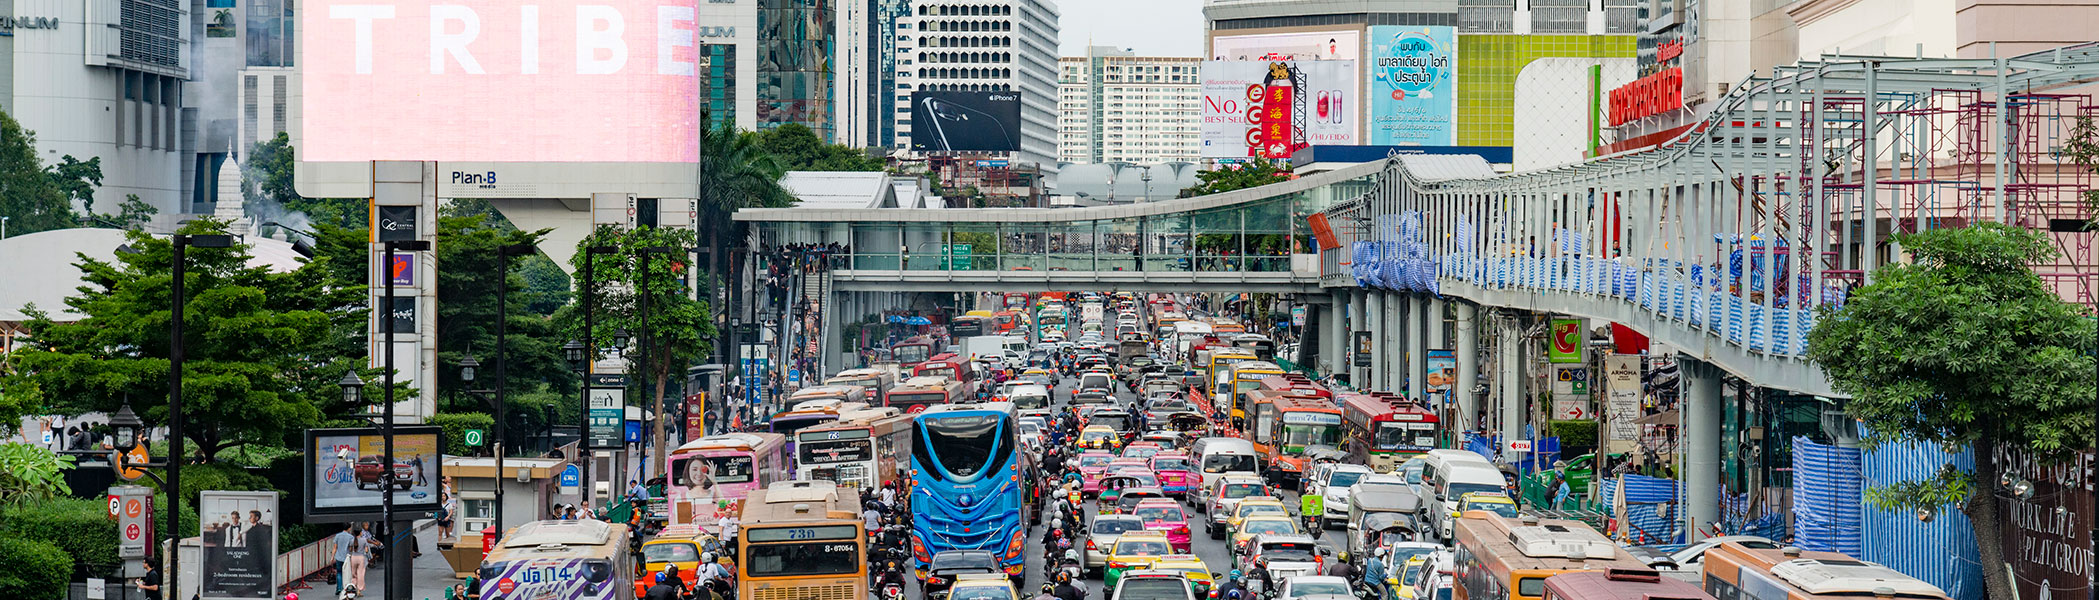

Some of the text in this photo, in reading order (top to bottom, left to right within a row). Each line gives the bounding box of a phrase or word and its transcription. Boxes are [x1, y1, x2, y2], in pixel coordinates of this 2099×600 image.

[329, 4, 695, 76] TRIBE
[1400, 41, 1426, 52] พบกับ
[1429, 53, 1448, 67] ไอที
[1394, 68, 1431, 85] ประตูน้ำ
[1204, 94, 1246, 114] No.
[1204, 116, 1225, 124] BEST
[1308, 133, 1350, 141] SHISEIDO
[1553, 322, 1569, 332] Big
[1306, 414, 1317, 422] 74
[112, 501, 119, 511] P
